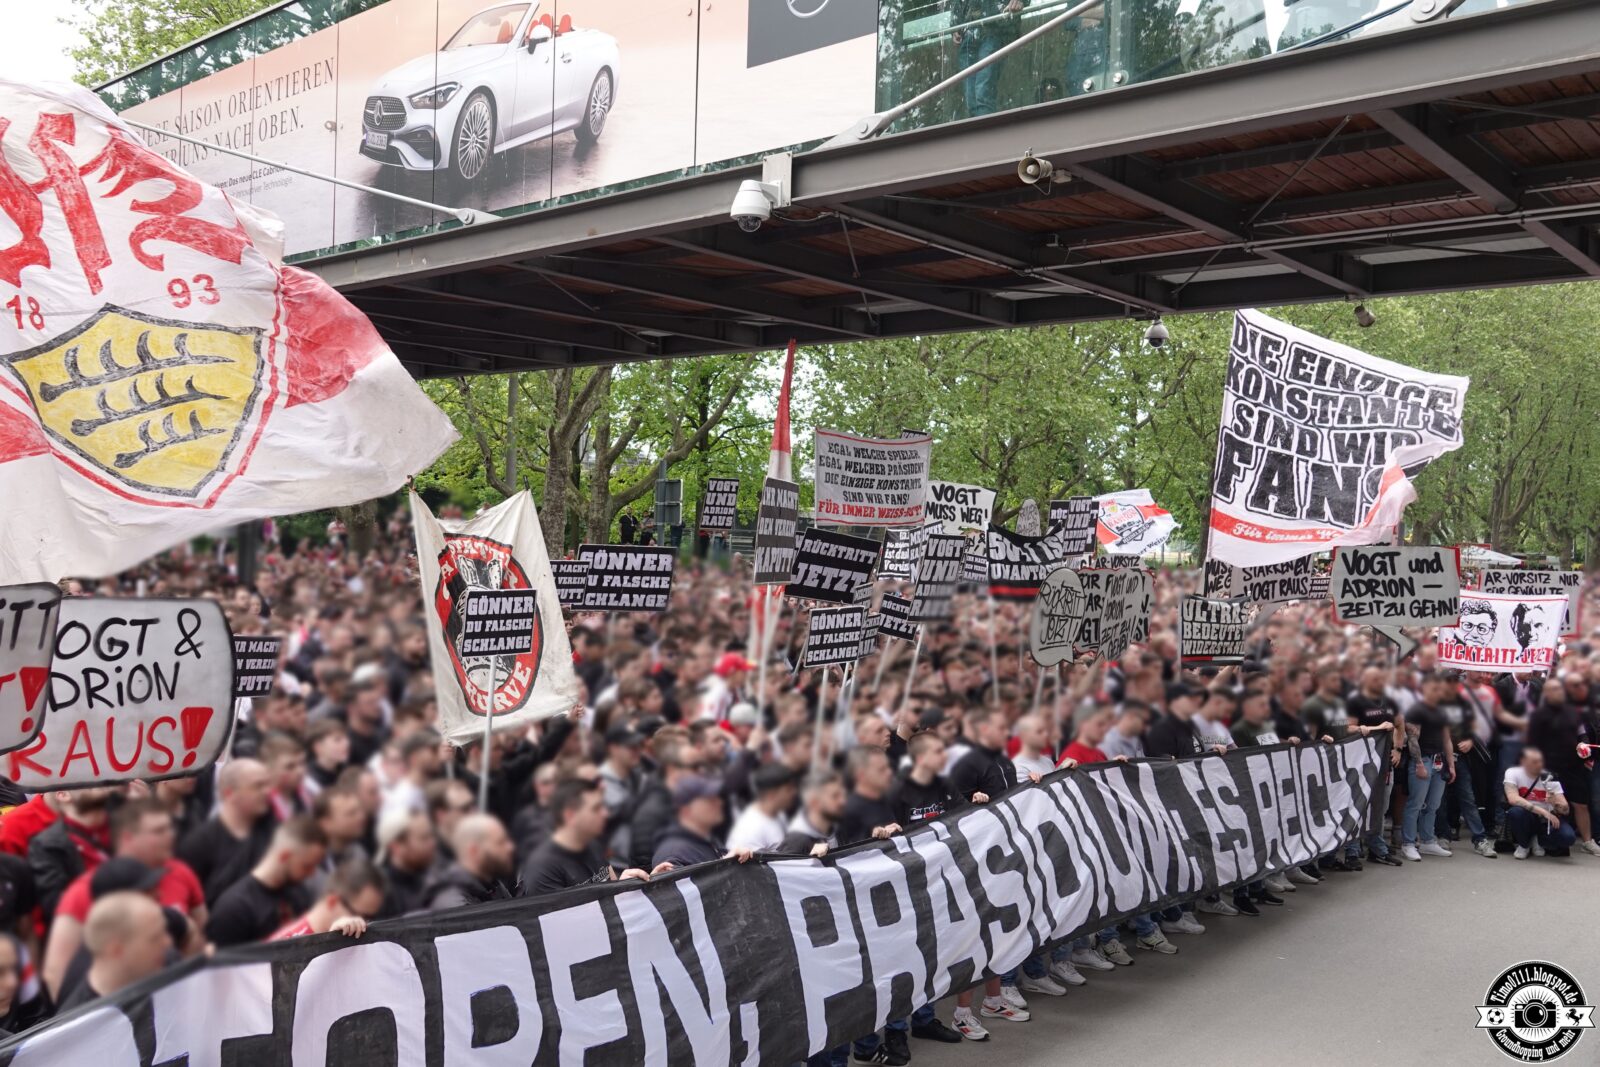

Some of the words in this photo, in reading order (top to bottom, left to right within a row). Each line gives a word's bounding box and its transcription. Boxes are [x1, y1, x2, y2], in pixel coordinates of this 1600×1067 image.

[174, 99, 223, 136] SAISON
[229, 57, 335, 118] ORIENTIEREN
[183, 137, 208, 167] UNS
[215, 122, 252, 157] NACH
[258, 106, 304, 141] OBEN.
[167, 273, 221, 308] 93
[6, 294, 46, 331] 18
[1232, 316, 1283, 374] DIE
[1289, 344, 1456, 411] EINZIGE
[1227, 356, 1459, 438] KONSTANTE
[1233, 402, 1319, 460] SIND
[828, 442, 852, 456] EGAL
[853, 446, 888, 460] WELCHE
[819, 454, 842, 470] EGAL
[844, 460, 886, 476] WELCHER
[708, 480, 738, 492] VOGT
[824, 472, 838, 485] DIE
[840, 475, 875, 490] EINZIGE
[876, 478, 922, 490] KONSTANTE
[705, 493, 736, 506] UND
[762, 486, 776, 506] IHR
[777, 489, 798, 511] MACHT
[842, 490, 864, 503] SIND
[865, 493, 884, 504] WIR
[932, 484, 981, 506] VOGT
[704, 506, 734, 515] ADRION
[818, 498, 840, 514] FÜR
[842, 504, 875, 518] IMMER
[924, 502, 956, 522] MUSS
[1071, 499, 1092, 512] VOGT
[701, 515, 732, 526] RAUS
[759, 517, 773, 535] DEN
[774, 518, 796, 537] VEREIN
[1067, 514, 1090, 529] UND
[1233, 524, 1263, 540] Für
[802, 538, 878, 564] RÜCKTRITT
[928, 538, 964, 557] VOGT
[1063, 540, 1086, 552] RAUS
[559, 564, 588, 573] MACHT
[580, 548, 673, 572] GÖNNER
[756, 546, 794, 574] KAPUTT
[1096, 556, 1140, 569] AR-VORSITZ
[1341, 549, 1401, 576] VOGT
[1408, 552, 1444, 574] und
[792, 562, 868, 593] JETZT
[920, 560, 959, 581] UND
[1484, 572, 1551, 586] AR-VORSITZ
[1559, 572, 1580, 586] NUR
[588, 575, 599, 586] U
[602, 575, 670, 589] FALSCHE
[1244, 580, 1276, 602] VOGT
[1279, 577, 1308, 595] RAUS
[1341, 576, 1416, 599] ADRION
[468, 596, 534, 615] GÖNNER
[585, 592, 668, 608] CHLANGE
[1338, 601, 1384, 619] ZEIT
[1384, 602, 1405, 618] ZU
[1410, 598, 1458, 618] GEHN!
[1183, 599, 1250, 624] ULTRAS
[466, 620, 482, 633] DU
[485, 617, 533, 632] FALSCHE
[811, 613, 861, 631] GÖNNER
[1183, 622, 1245, 640] BEDEUTET
[55, 617, 160, 661] OGT
[174, 608, 204, 659] &
[463, 633, 531, 653] SCHLANGE
[809, 635, 821, 645] DU
[823, 631, 860, 644] FALSCHE
[807, 646, 858, 662] SCHLANGE
[49, 662, 180, 712] DRiON
[9, 706, 214, 782] RAUS!
[1196, 771, 1260, 889] ES
